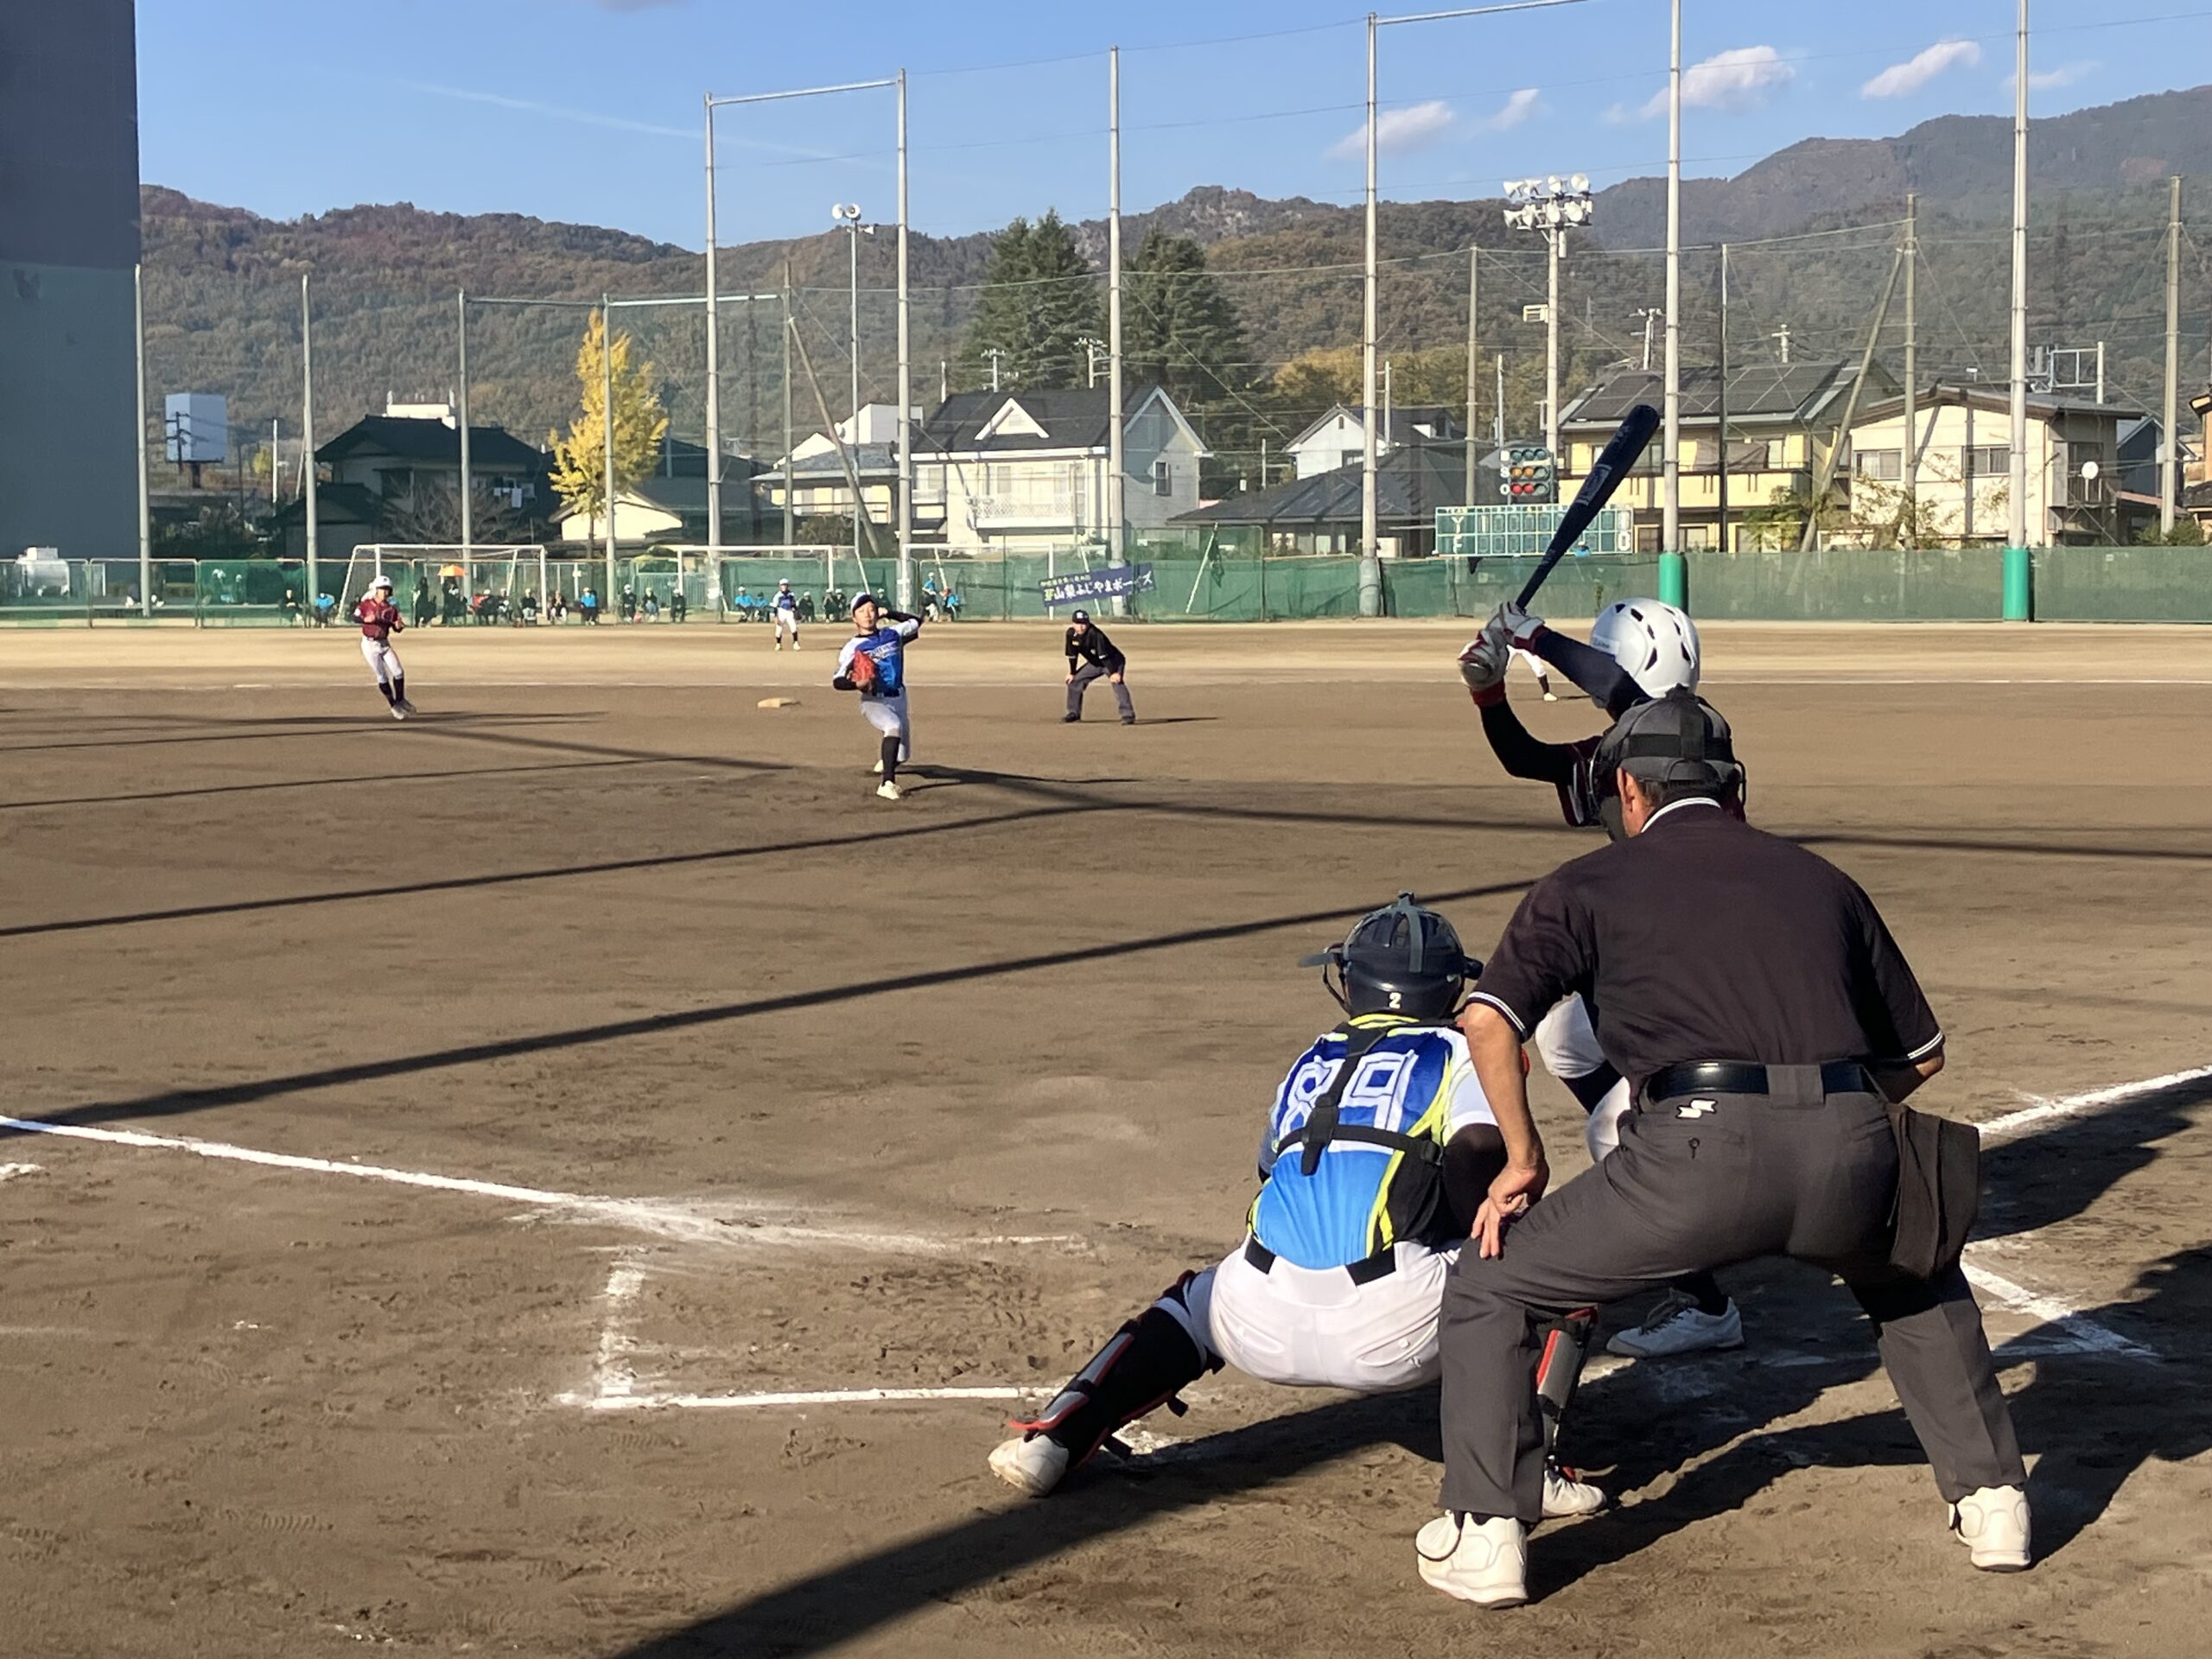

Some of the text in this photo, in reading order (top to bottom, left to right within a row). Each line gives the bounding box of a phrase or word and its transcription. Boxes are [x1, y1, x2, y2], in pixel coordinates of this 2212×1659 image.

[1500, 467, 1510, 478] S
[1451, 515, 1465, 533] Y
[1388, 992, 1402, 1008] 2
[1279, 1049, 1419, 1153] 89
